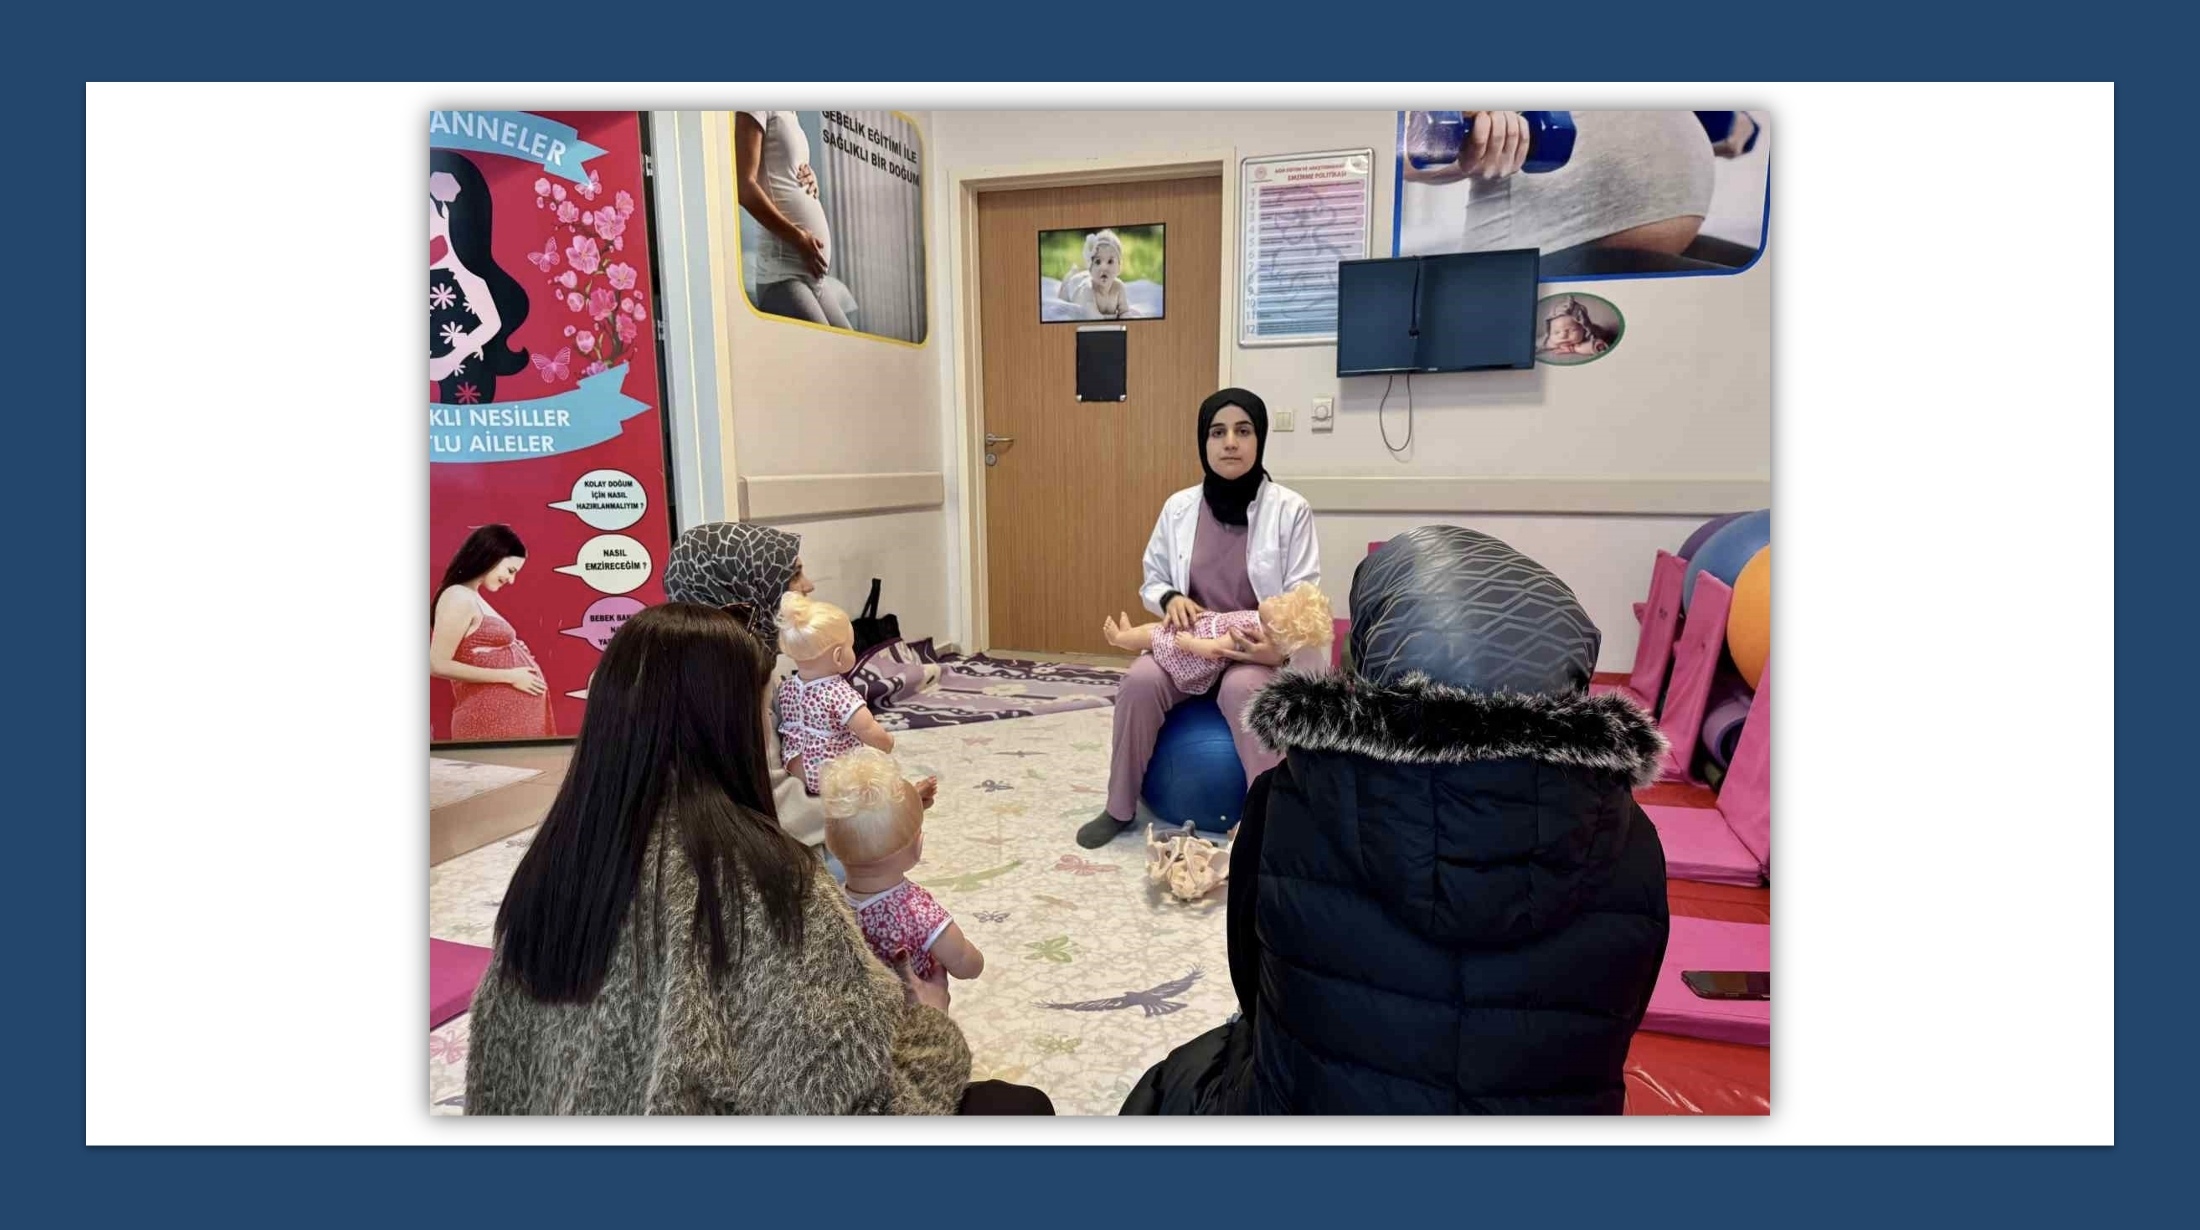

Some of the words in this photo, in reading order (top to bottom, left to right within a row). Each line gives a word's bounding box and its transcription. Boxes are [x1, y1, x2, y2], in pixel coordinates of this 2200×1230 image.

[430, 111, 566, 167] ANNELER
[822, 111, 866, 139] GEBELİK
[867, 127, 902, 157] EĞİTİMİ
[822, 129, 869, 163] SAĞLIKLI
[871, 152, 887, 171] BİR
[889, 162, 920, 187] DOĞUM
[430, 408, 462, 427] KLI
[470, 405, 571, 427] NESİLLER
[430, 434, 462, 453] LU
[469, 431, 556, 453] AİLELER
[584, 480, 607, 488] KOLAY
[608, 479, 633, 488] DOĞUM
[591, 490, 606, 500] İÇİN
[607, 491, 628, 499] NASIL
[576, 502, 639, 511] HAZIRLANMALIYIM
[640, 502, 645, 510] ?
[603, 549, 627, 557] NASIL
[585, 561, 639, 571] EMZİRECEĞİM
[642, 562, 648, 570] ?
[590, 614, 615, 622] BEBEK
